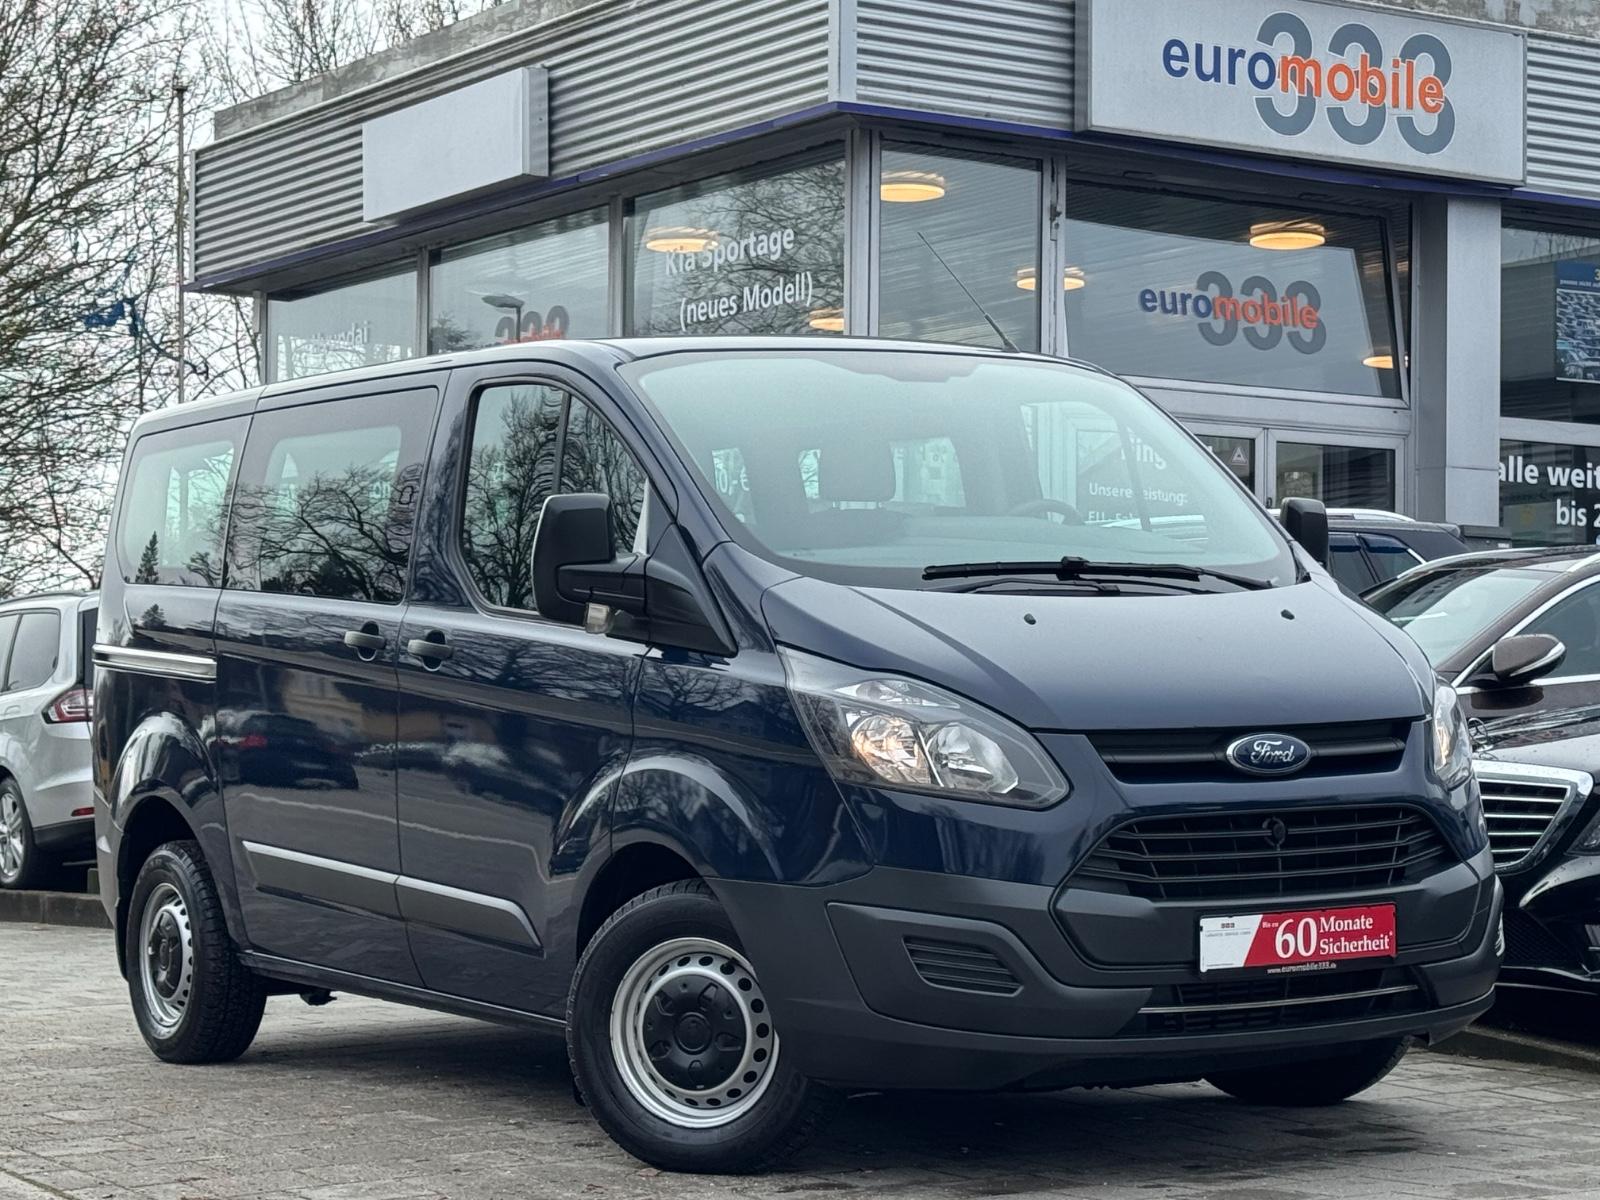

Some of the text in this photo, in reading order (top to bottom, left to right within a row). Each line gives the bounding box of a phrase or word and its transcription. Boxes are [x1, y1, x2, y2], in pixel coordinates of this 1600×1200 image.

[1163, 12, 1456, 155] euromobile 333
[702, 228, 795, 272] Sportage
[679, 271, 813, 332] (neues Modell)
[1139, 287, 1320, 330] euromobile
[1499, 455, 1540, 485] alle
[1089, 482, 1188, 506] Unsere eistung:
[1556, 498, 1588, 527] bis
[1250, 740, 1295, 763] Ford
[1275, 914, 1374, 959] 60 Monate
